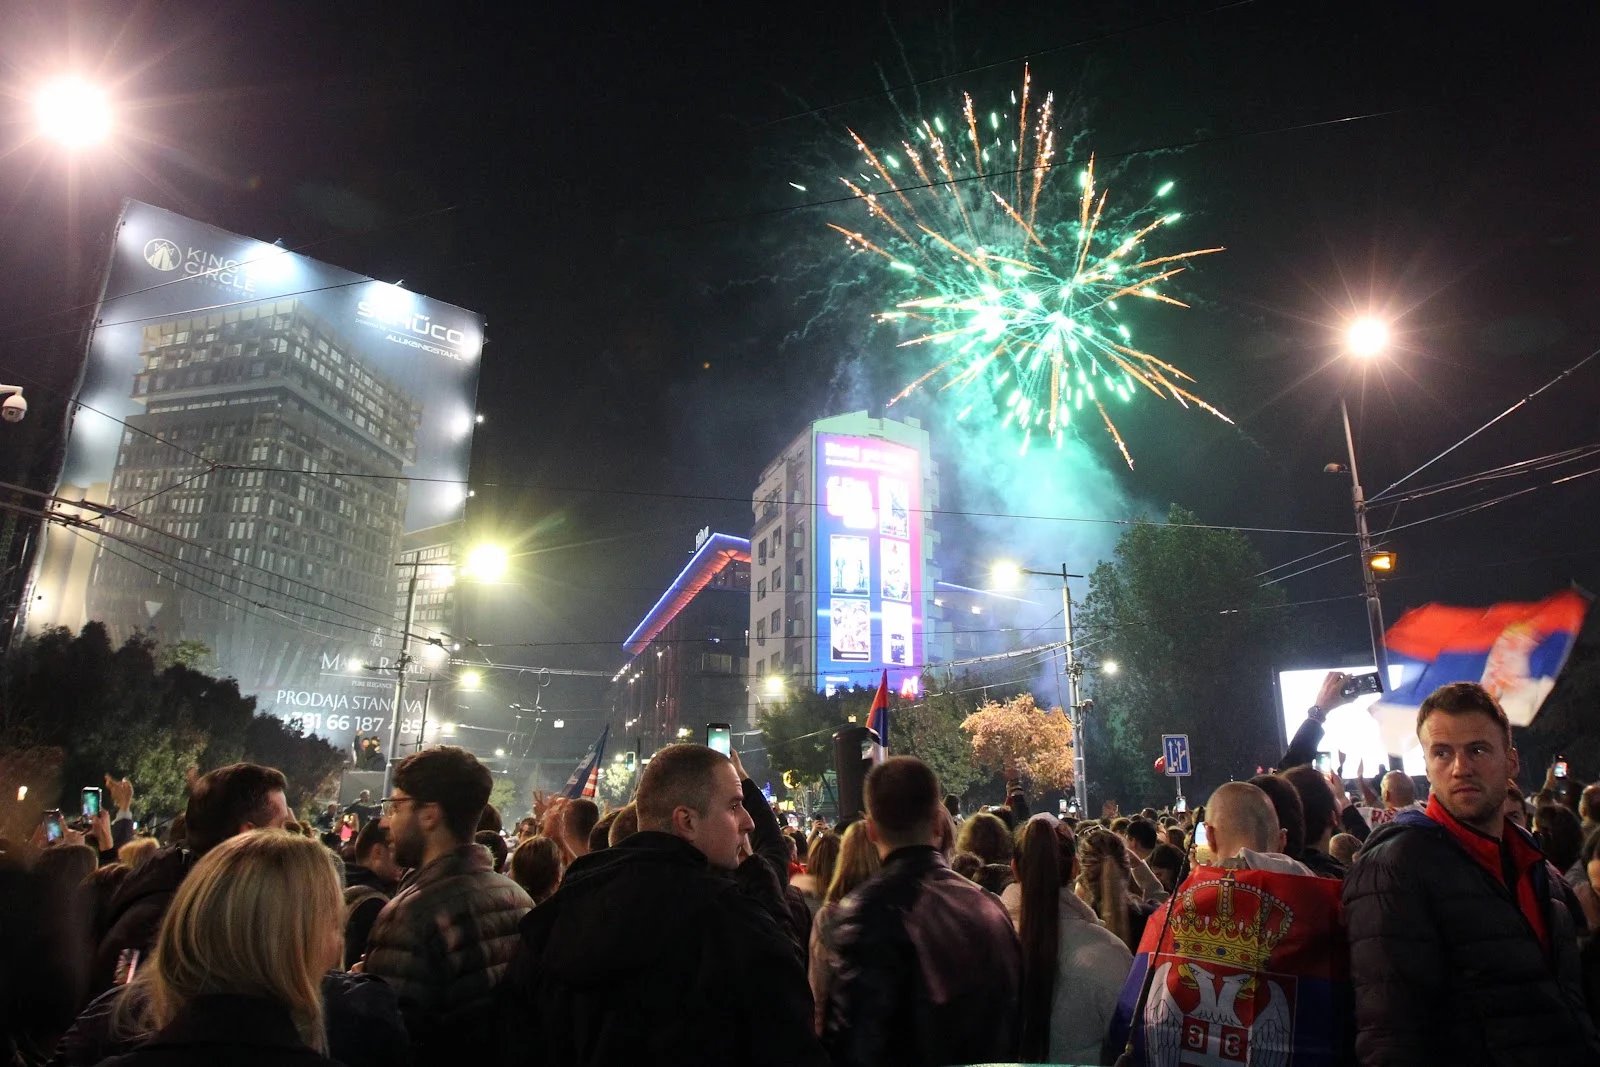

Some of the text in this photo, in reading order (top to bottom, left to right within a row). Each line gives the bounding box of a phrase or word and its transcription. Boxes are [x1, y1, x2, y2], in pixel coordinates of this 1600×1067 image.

[184, 262, 256, 293] CIRCLE
[357, 300, 467, 346] SÜCO
[378, 656, 425, 675] ROALE
[276, 690, 349, 711] PRODAJA
[326, 714, 349, 731] 66
[355, 716, 384, 732] 187
